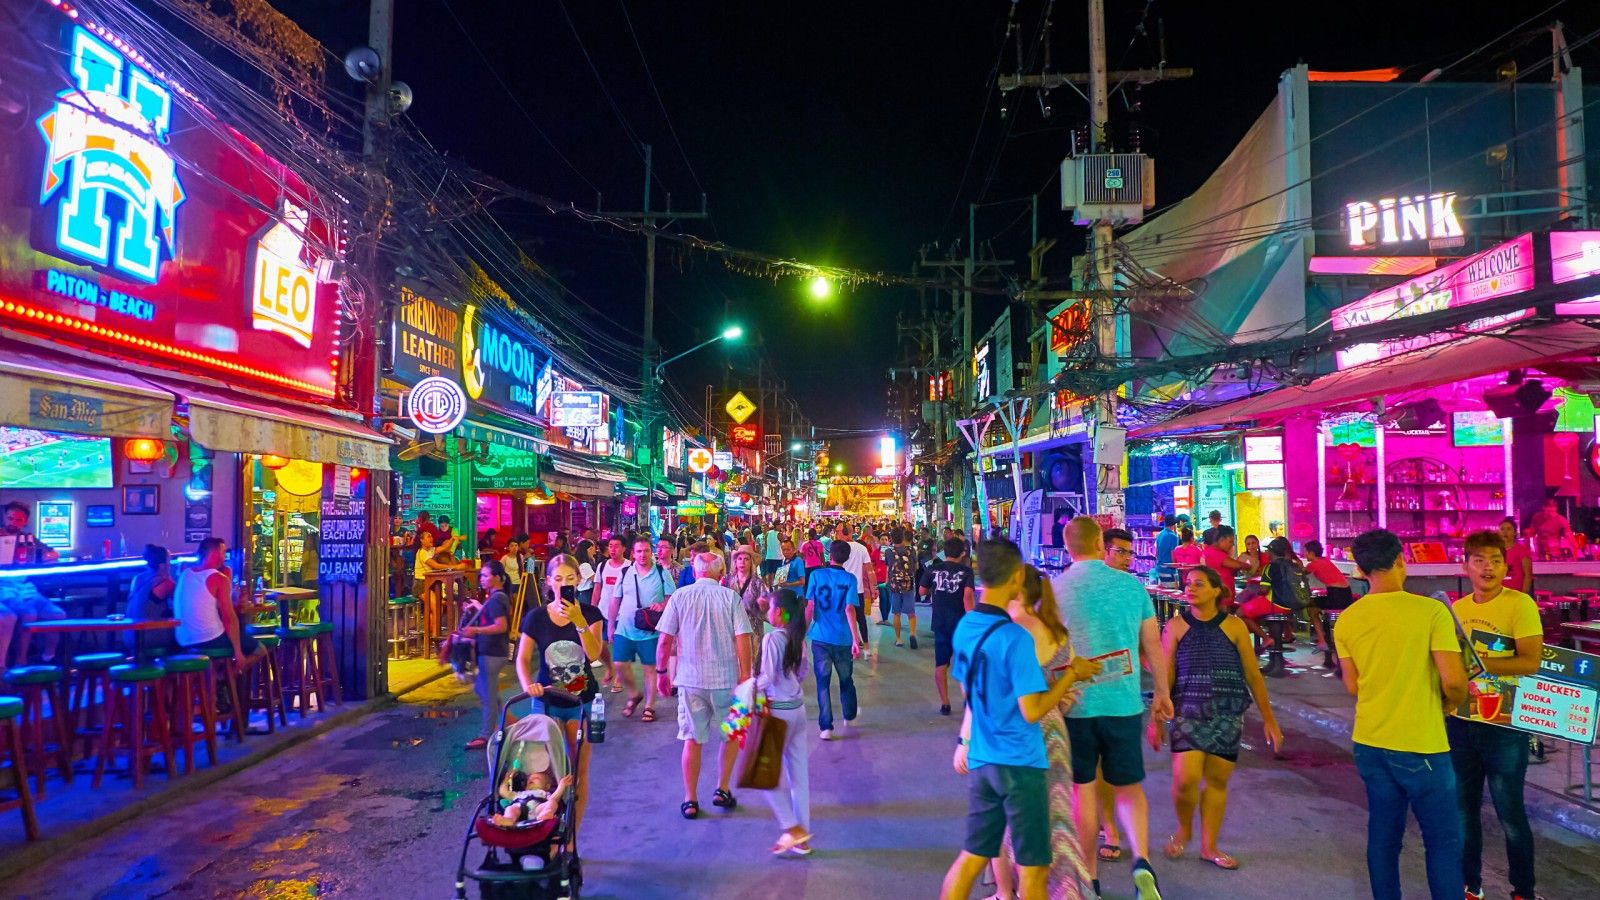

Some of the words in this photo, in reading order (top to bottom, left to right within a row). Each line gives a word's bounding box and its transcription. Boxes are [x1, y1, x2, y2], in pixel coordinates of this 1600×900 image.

[1345, 191, 1464, 246] PINK
[1468, 245, 1520, 282] WELCOME
[259, 259, 310, 323] LEO
[109, 290, 155, 321] BEACH
[401, 286, 457, 343] FRIENDSHIP
[402, 330, 456, 370] LEATHER
[482, 322, 535, 385] MOON
[514, 387, 534, 408] BAR
[40, 394, 68, 419] San
[68, 398, 97, 427] Mig
[506, 457, 533, 468] BAR
[348, 501, 366, 516] STAFF
[323, 531, 345, 540] EACH
[346, 531, 363, 540] DAY
[320, 562, 332, 574] DJ
[335, 562, 364, 574] BANK
[1540, 660, 1565, 673] ILEY
[1523, 692, 1552, 705] VODKA
[1536, 681, 1581, 699] BUCKETS
[1521, 703, 1557, 717] WHISKEY
[1519, 714, 1557, 729] COCKTAIL
